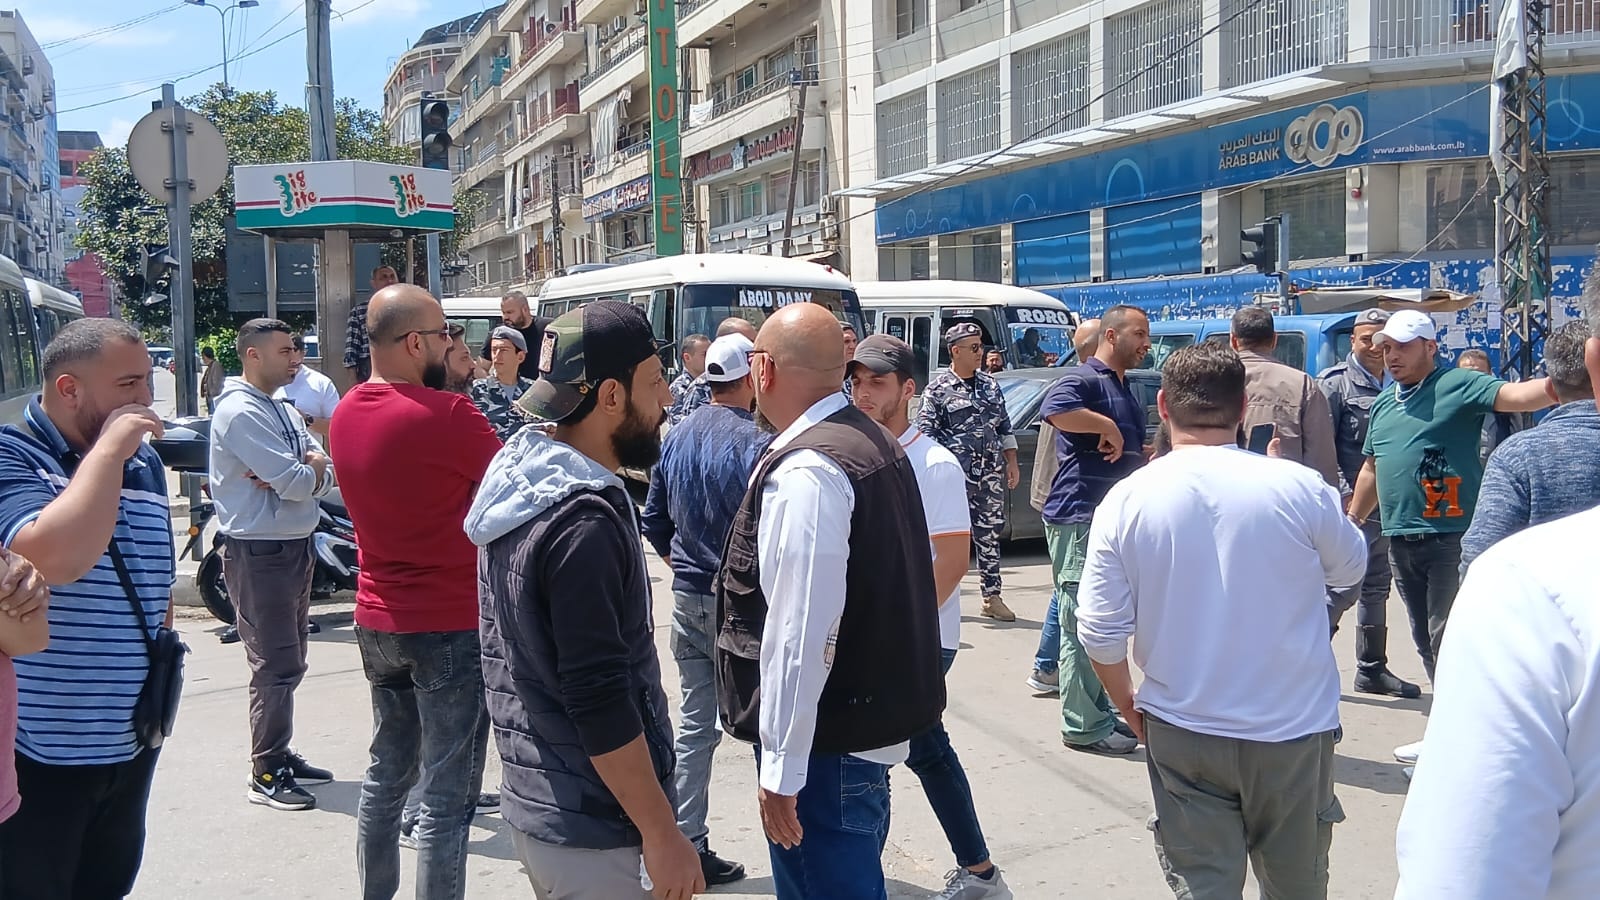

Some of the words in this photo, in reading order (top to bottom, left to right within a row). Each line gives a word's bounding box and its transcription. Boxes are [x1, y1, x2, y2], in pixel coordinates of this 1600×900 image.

[656, 0, 677, 233] TOLE
[1219, 133, 1251, 155] العربي
[1252, 127, 1280, 146] البنك
[1373, 141, 1465, 154] www.arabbank.com.lb
[1218, 153, 1247, 170] ARAB
[1249, 146, 1280, 165] BANK
[739, 289, 773, 307] ABOU
[1017, 308, 1069, 325] RORO
